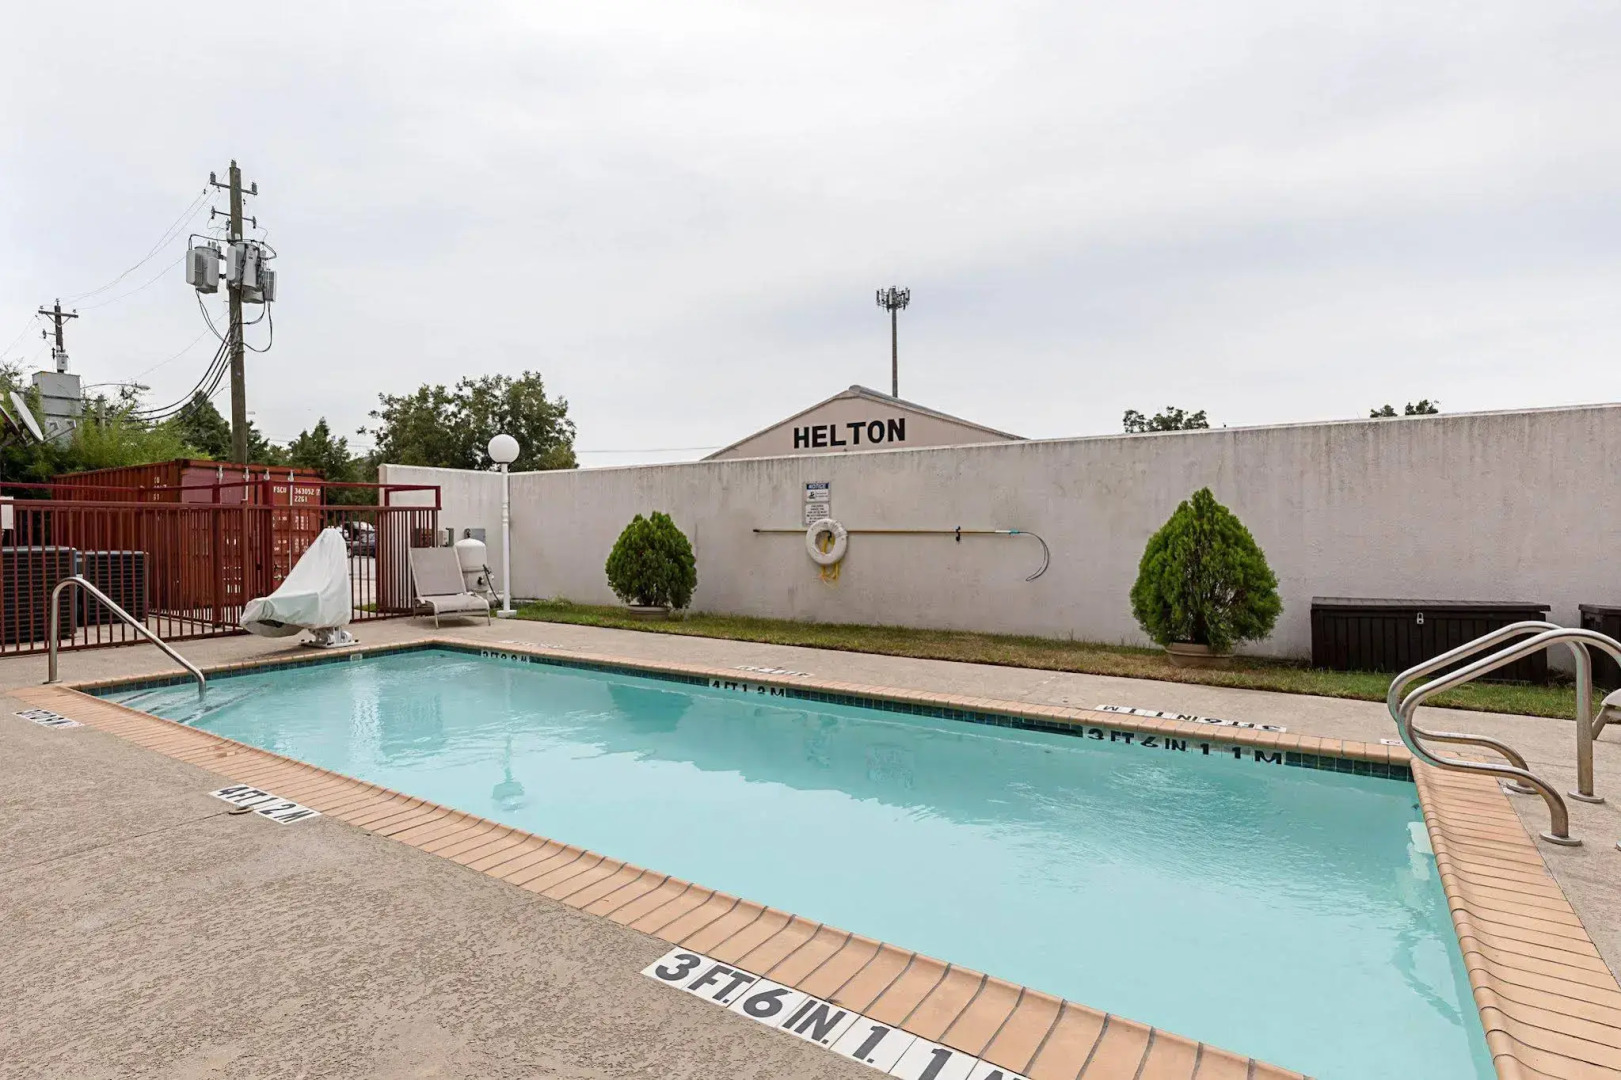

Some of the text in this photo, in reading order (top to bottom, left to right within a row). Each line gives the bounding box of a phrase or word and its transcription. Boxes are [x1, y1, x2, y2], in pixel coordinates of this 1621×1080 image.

[793, 417, 905, 449] HELTON
[1255, 750, 1282, 765] M
[655, 953, 701, 982] 3
[743, 987, 793, 1019] 6
[919, 1048, 953, 1080] 1
